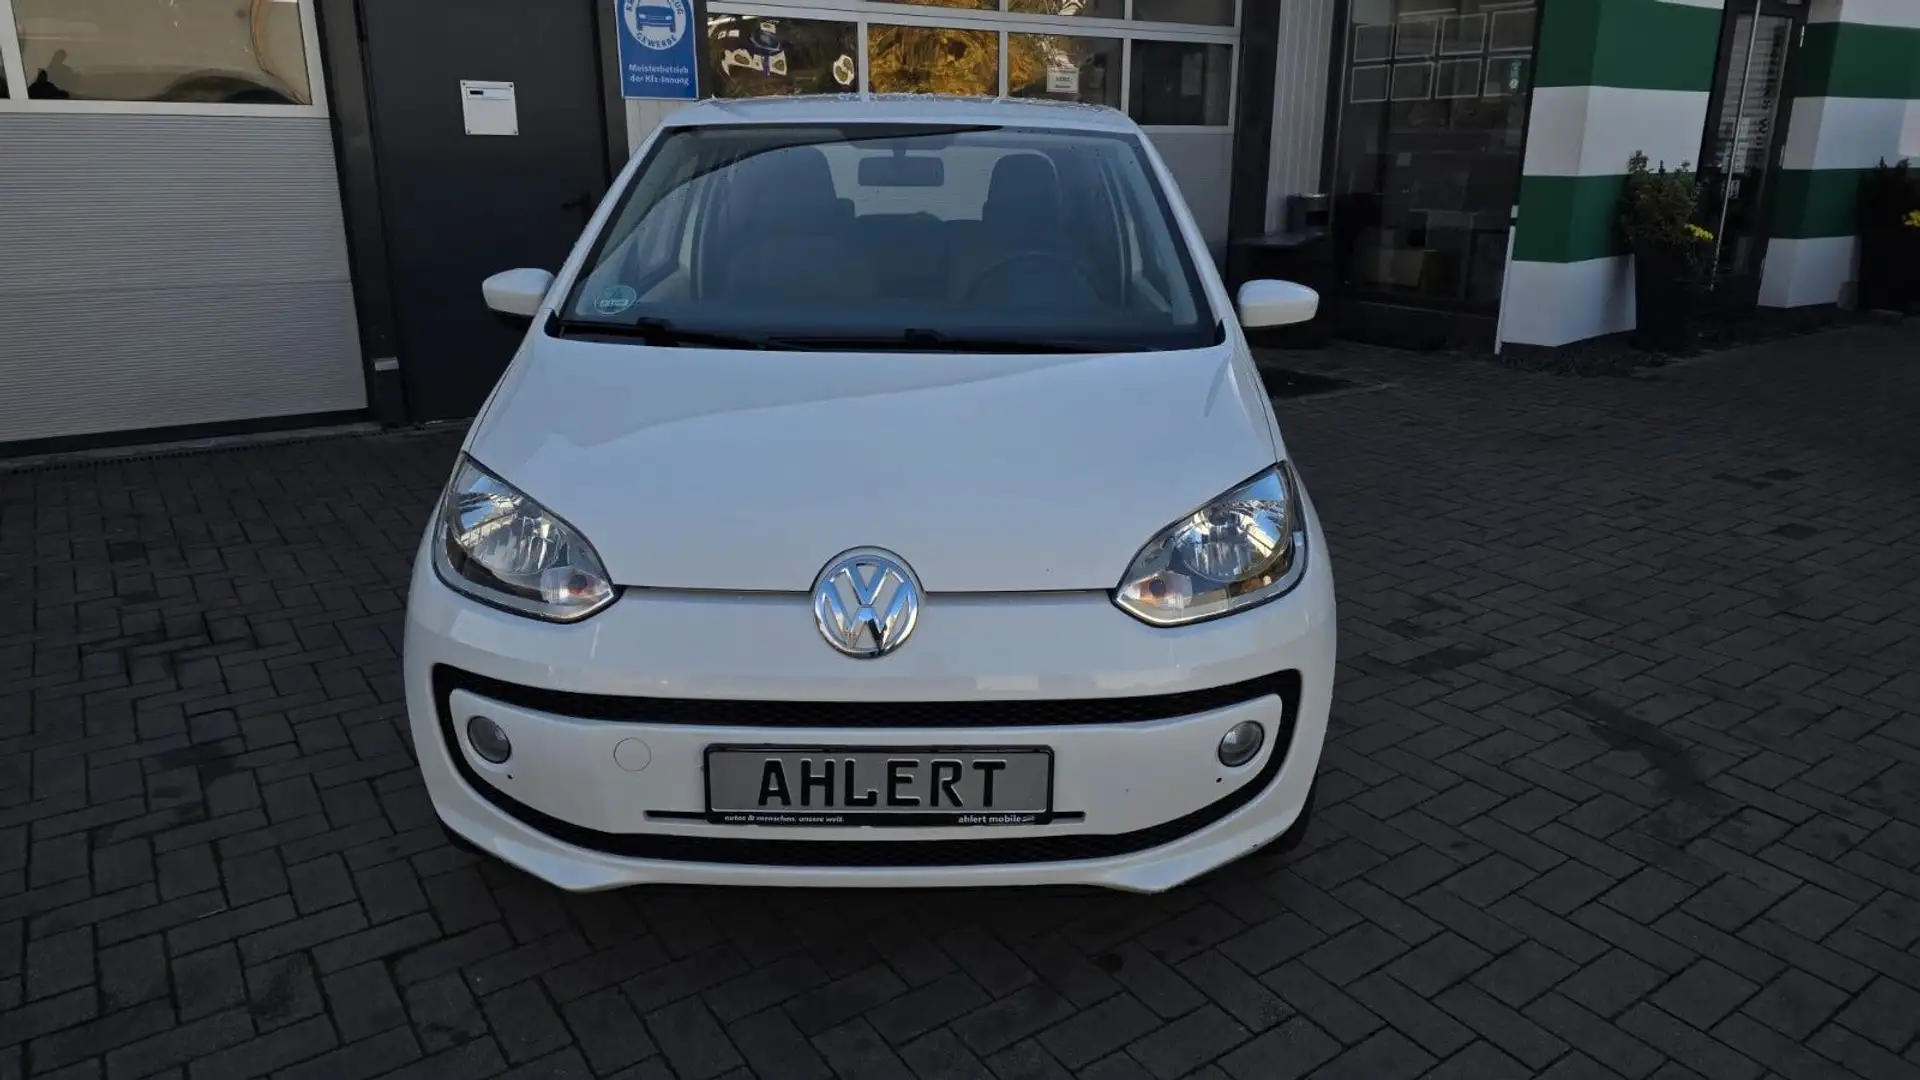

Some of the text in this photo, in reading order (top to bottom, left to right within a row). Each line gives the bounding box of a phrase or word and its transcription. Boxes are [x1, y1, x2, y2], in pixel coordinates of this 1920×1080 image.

[636, 32, 677, 48] GEWERBE
[628, 64, 689, 74] Meisterbetrieb
[630, 74, 690, 86] der Kfz-Innung
[815, 554, 919, 659] VW
[758, 758, 1007, 807] AHLERT
[958, 814, 1021, 823] ahlert mobile
